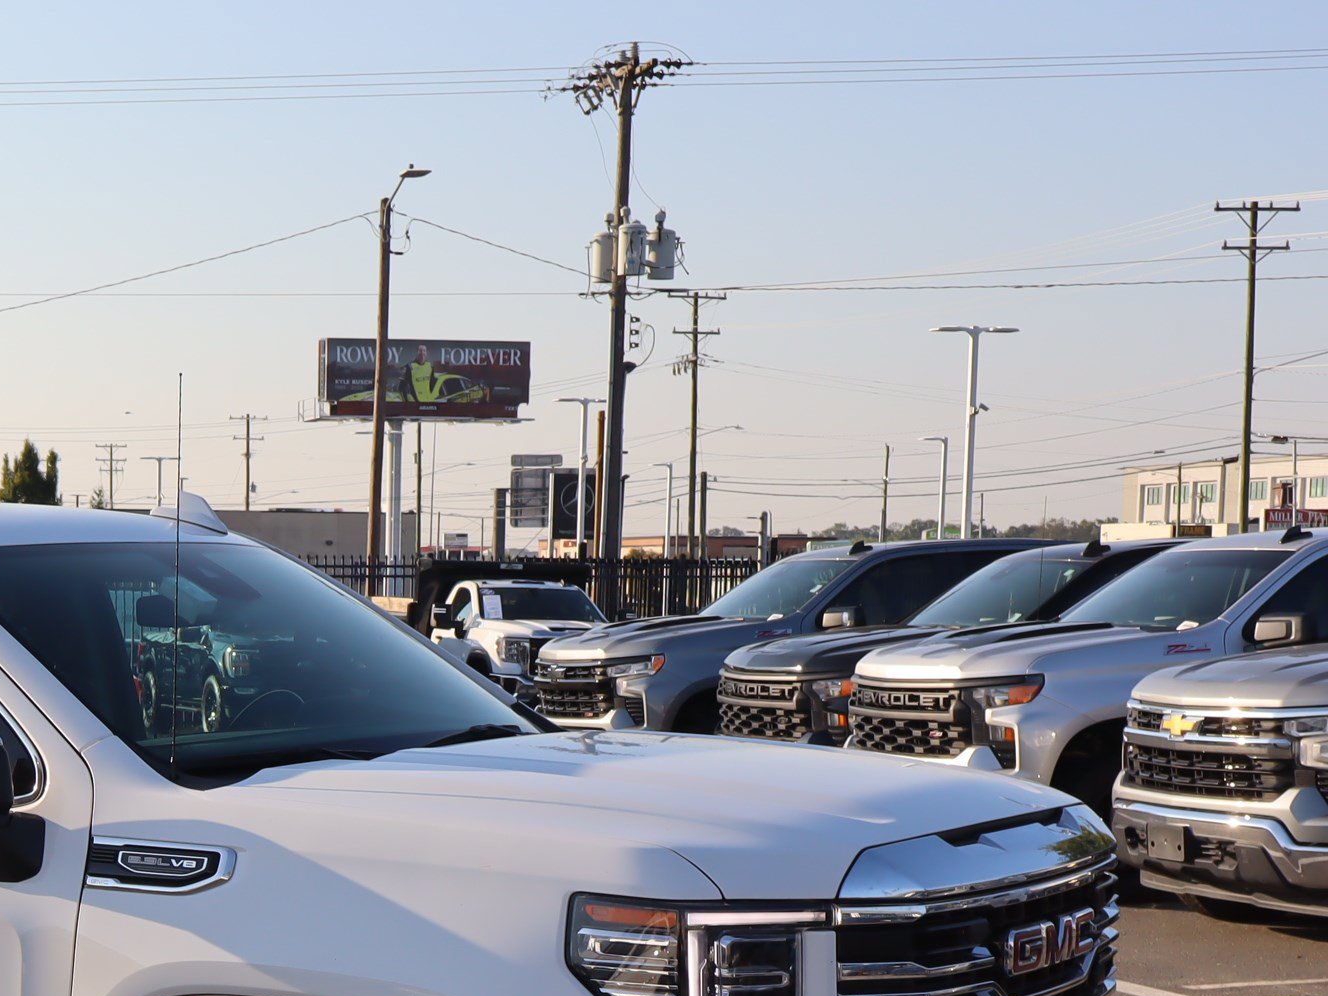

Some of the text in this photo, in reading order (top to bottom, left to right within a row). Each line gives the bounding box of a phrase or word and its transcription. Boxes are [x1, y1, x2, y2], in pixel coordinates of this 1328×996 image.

[440, 347, 521, 366] FOREVER
[1269, 511, 1303, 521] MILLR
[851, 688, 949, 709] CHEVROLET
[1004, 908, 1096, 977] GMC
